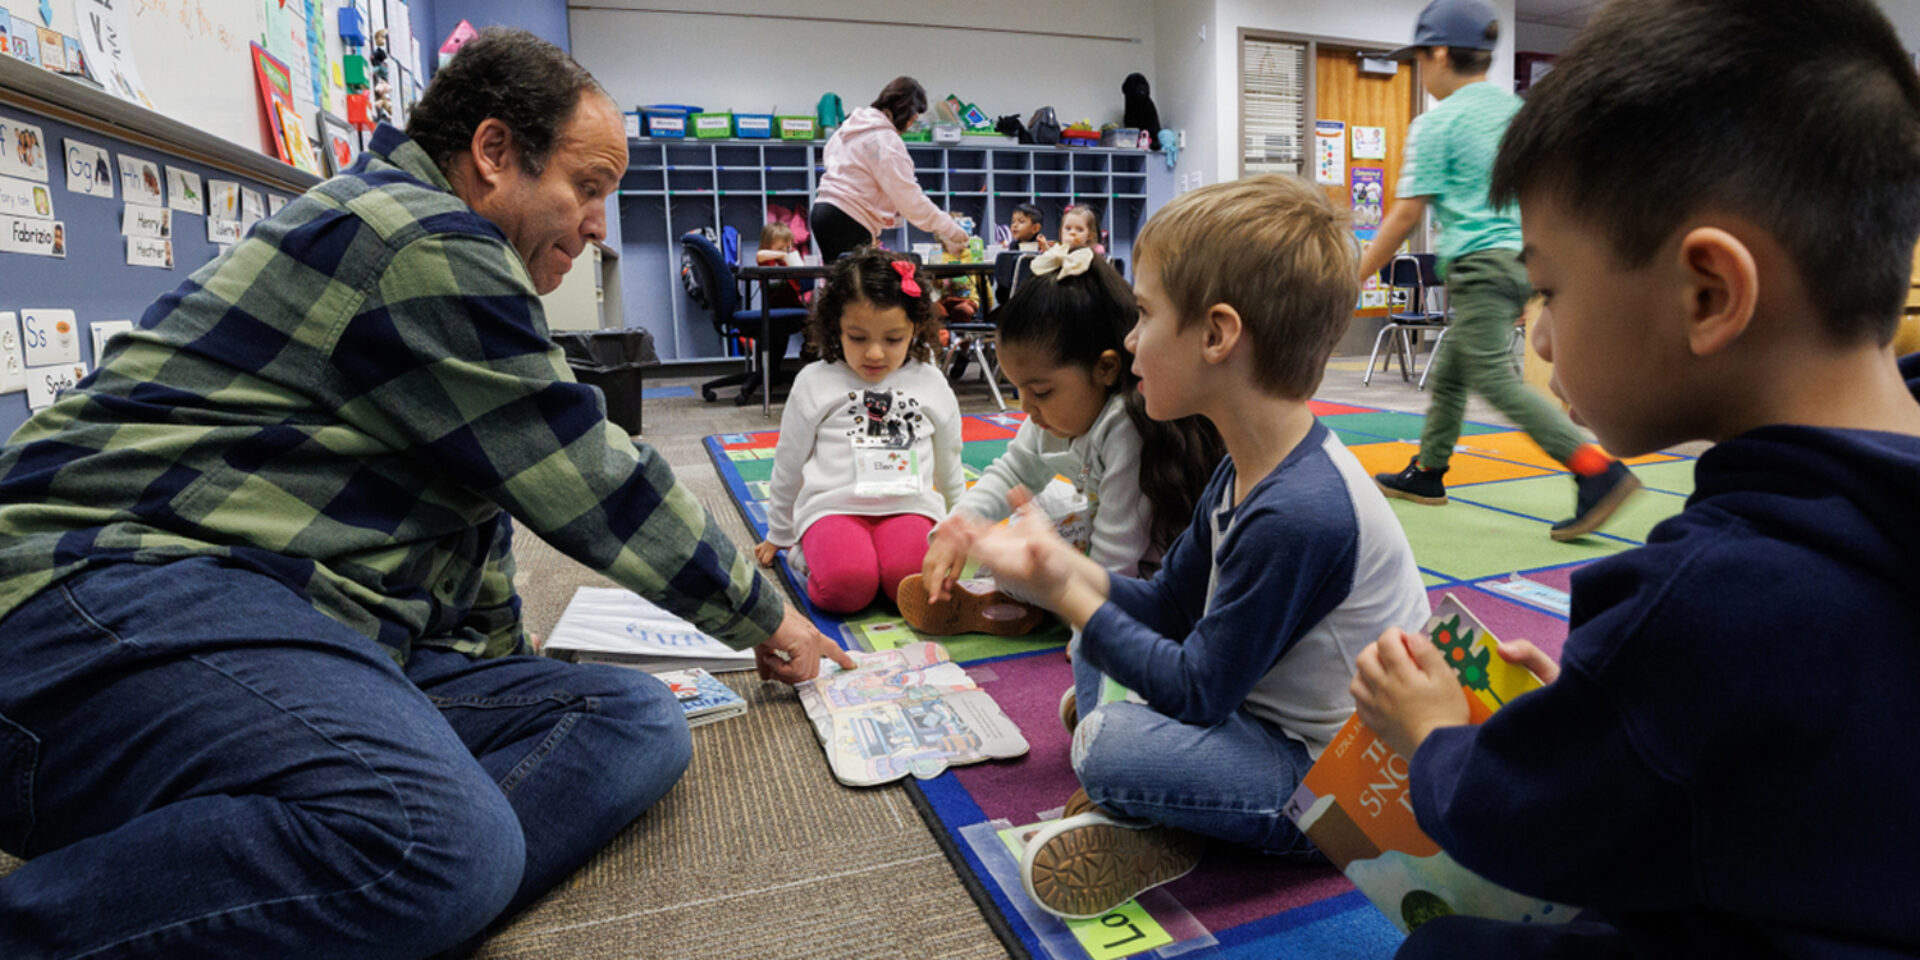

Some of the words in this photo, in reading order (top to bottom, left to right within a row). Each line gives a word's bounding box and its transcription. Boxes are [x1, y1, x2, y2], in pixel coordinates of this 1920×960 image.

[68, 146, 93, 192] Gg
[12, 220, 52, 244] Fabrizio
[137, 211, 160, 233] Henry
[25, 315, 47, 348] Ss
[1360, 737, 1388, 764] TH
[1359, 752, 1410, 819] SNO
[1101, 899, 1147, 950] Lo
